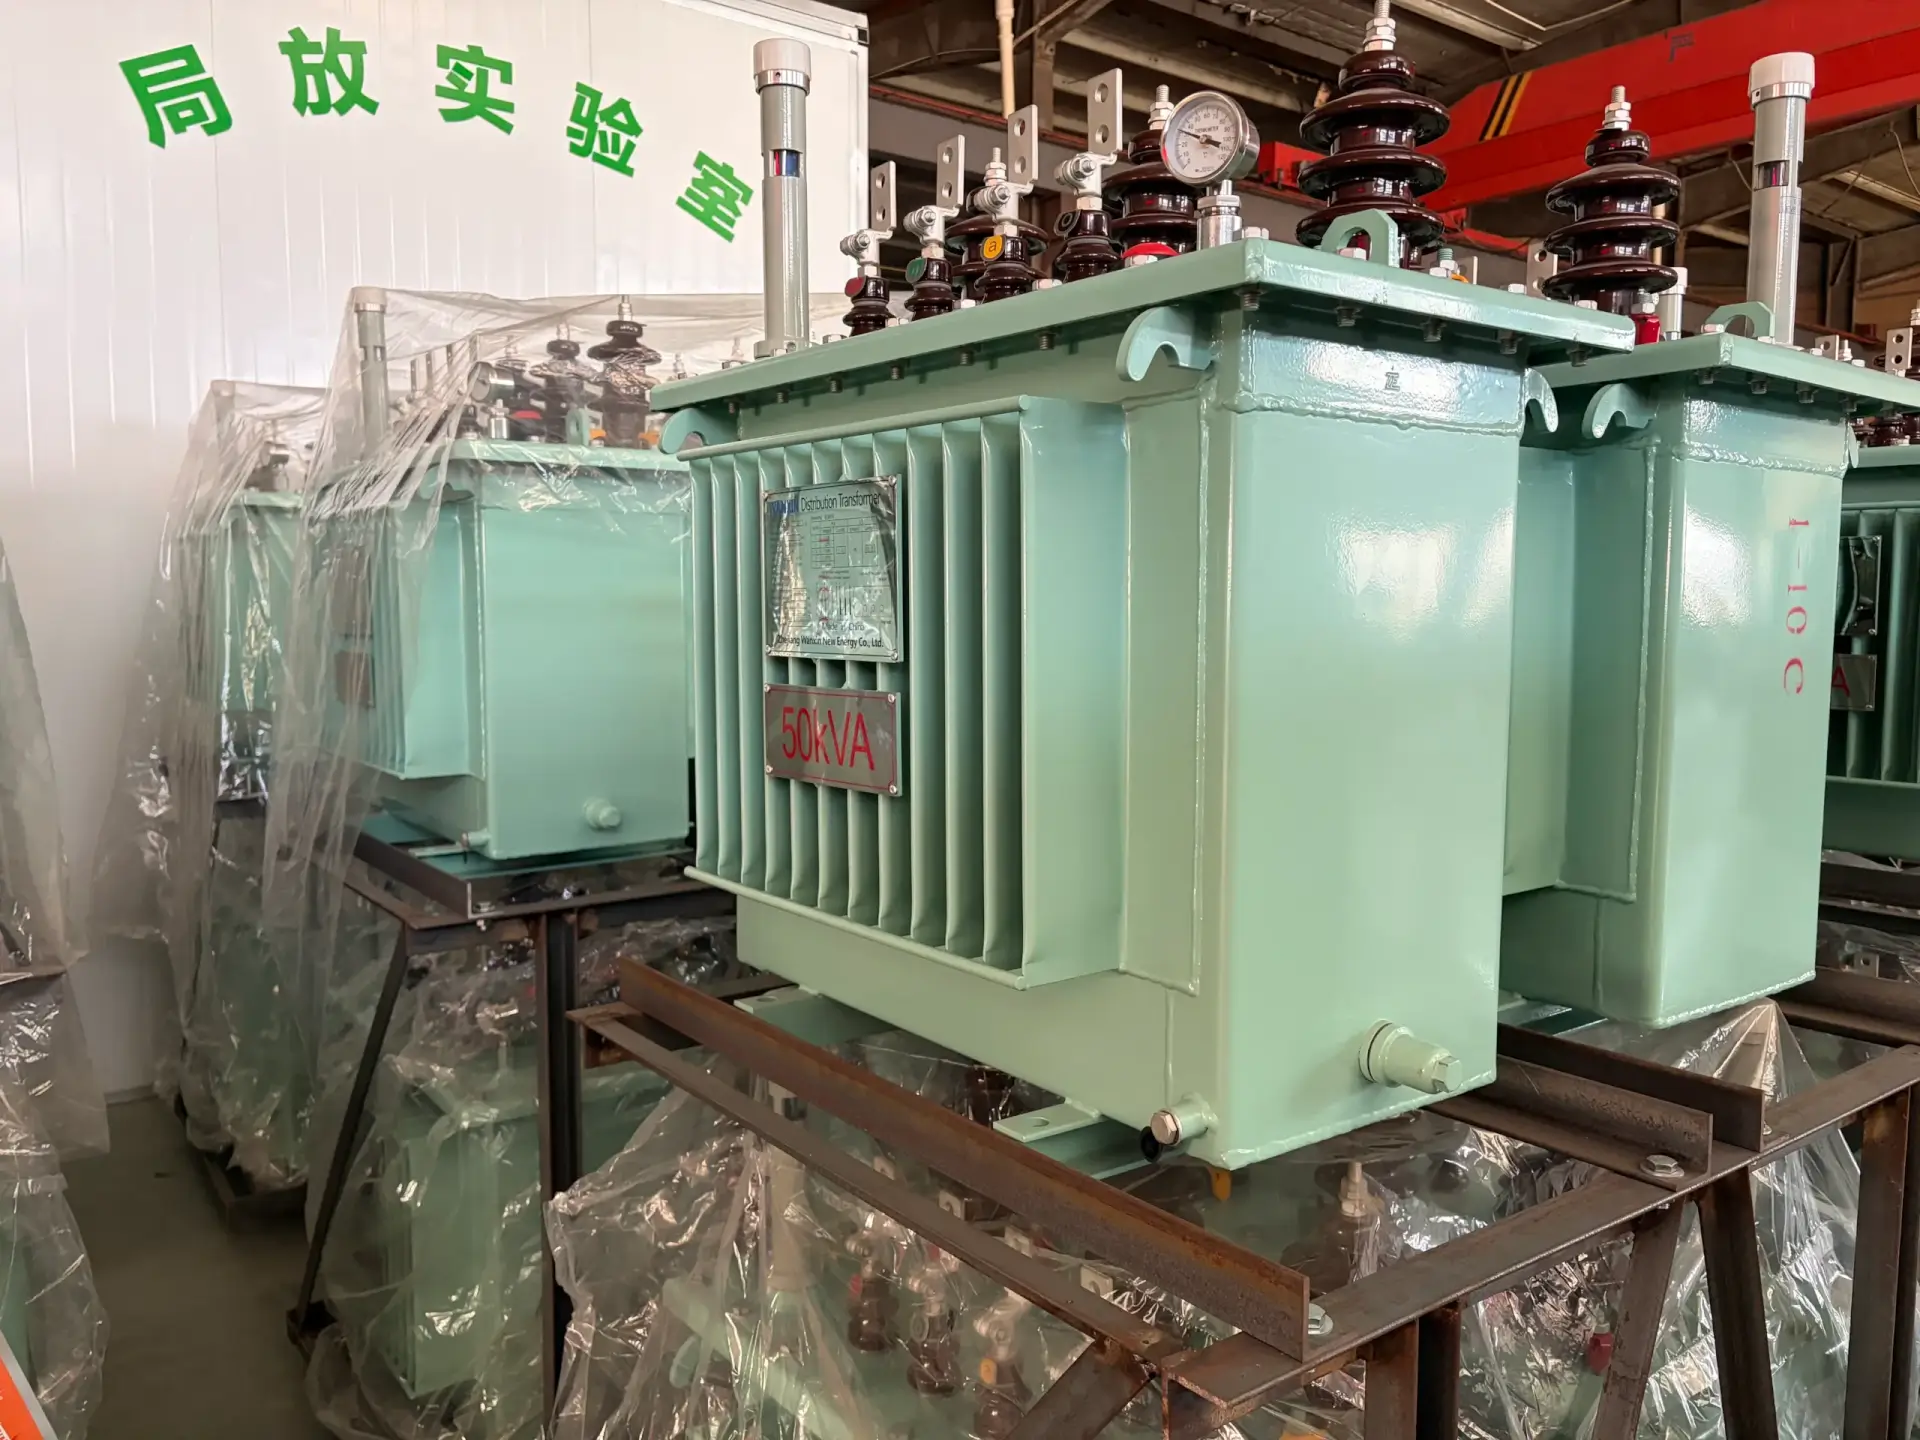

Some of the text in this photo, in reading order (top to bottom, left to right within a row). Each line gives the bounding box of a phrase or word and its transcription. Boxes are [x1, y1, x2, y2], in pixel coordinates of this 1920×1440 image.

[119, 26, 754, 243] 局放实验室
[801, 494, 837, 511] Distribution
[782, 706, 875, 771] 50kVA
